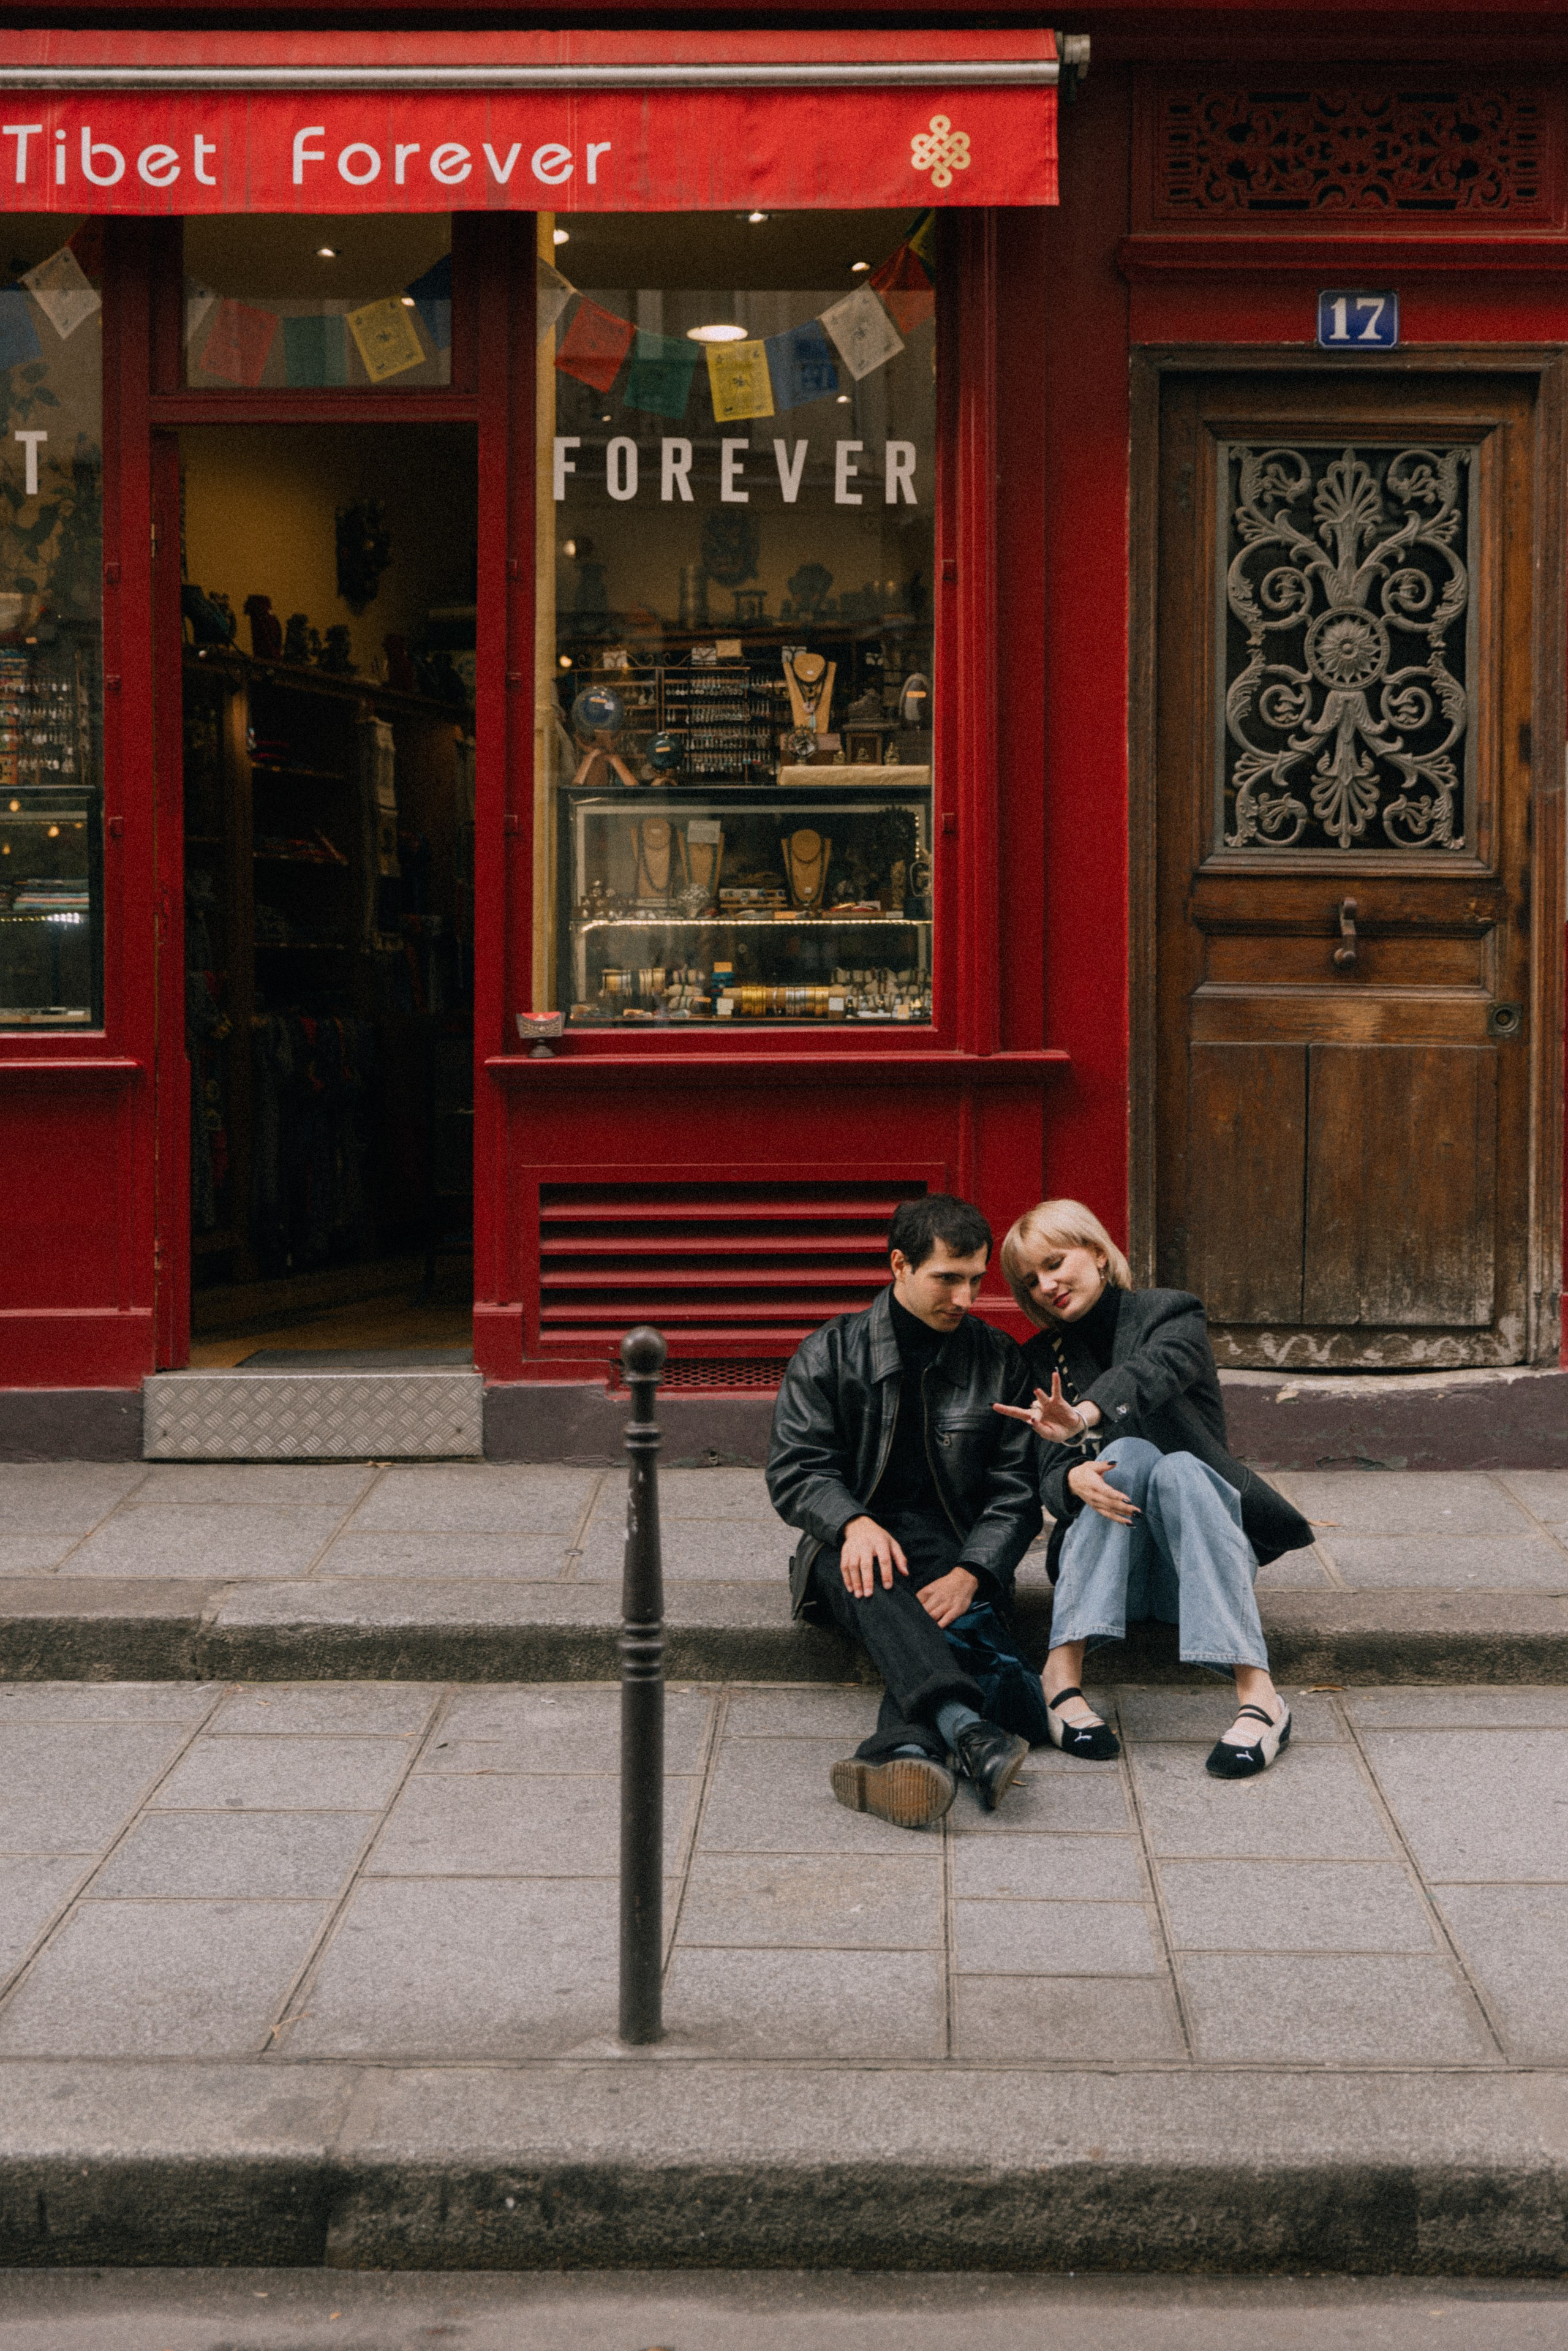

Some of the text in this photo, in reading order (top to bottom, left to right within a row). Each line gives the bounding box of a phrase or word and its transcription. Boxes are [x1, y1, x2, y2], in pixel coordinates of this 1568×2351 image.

[2, 124, 612, 187] Tibet Forever
[1329, 297, 1386, 340] 17
[552, 436, 918, 505] FOREVER
